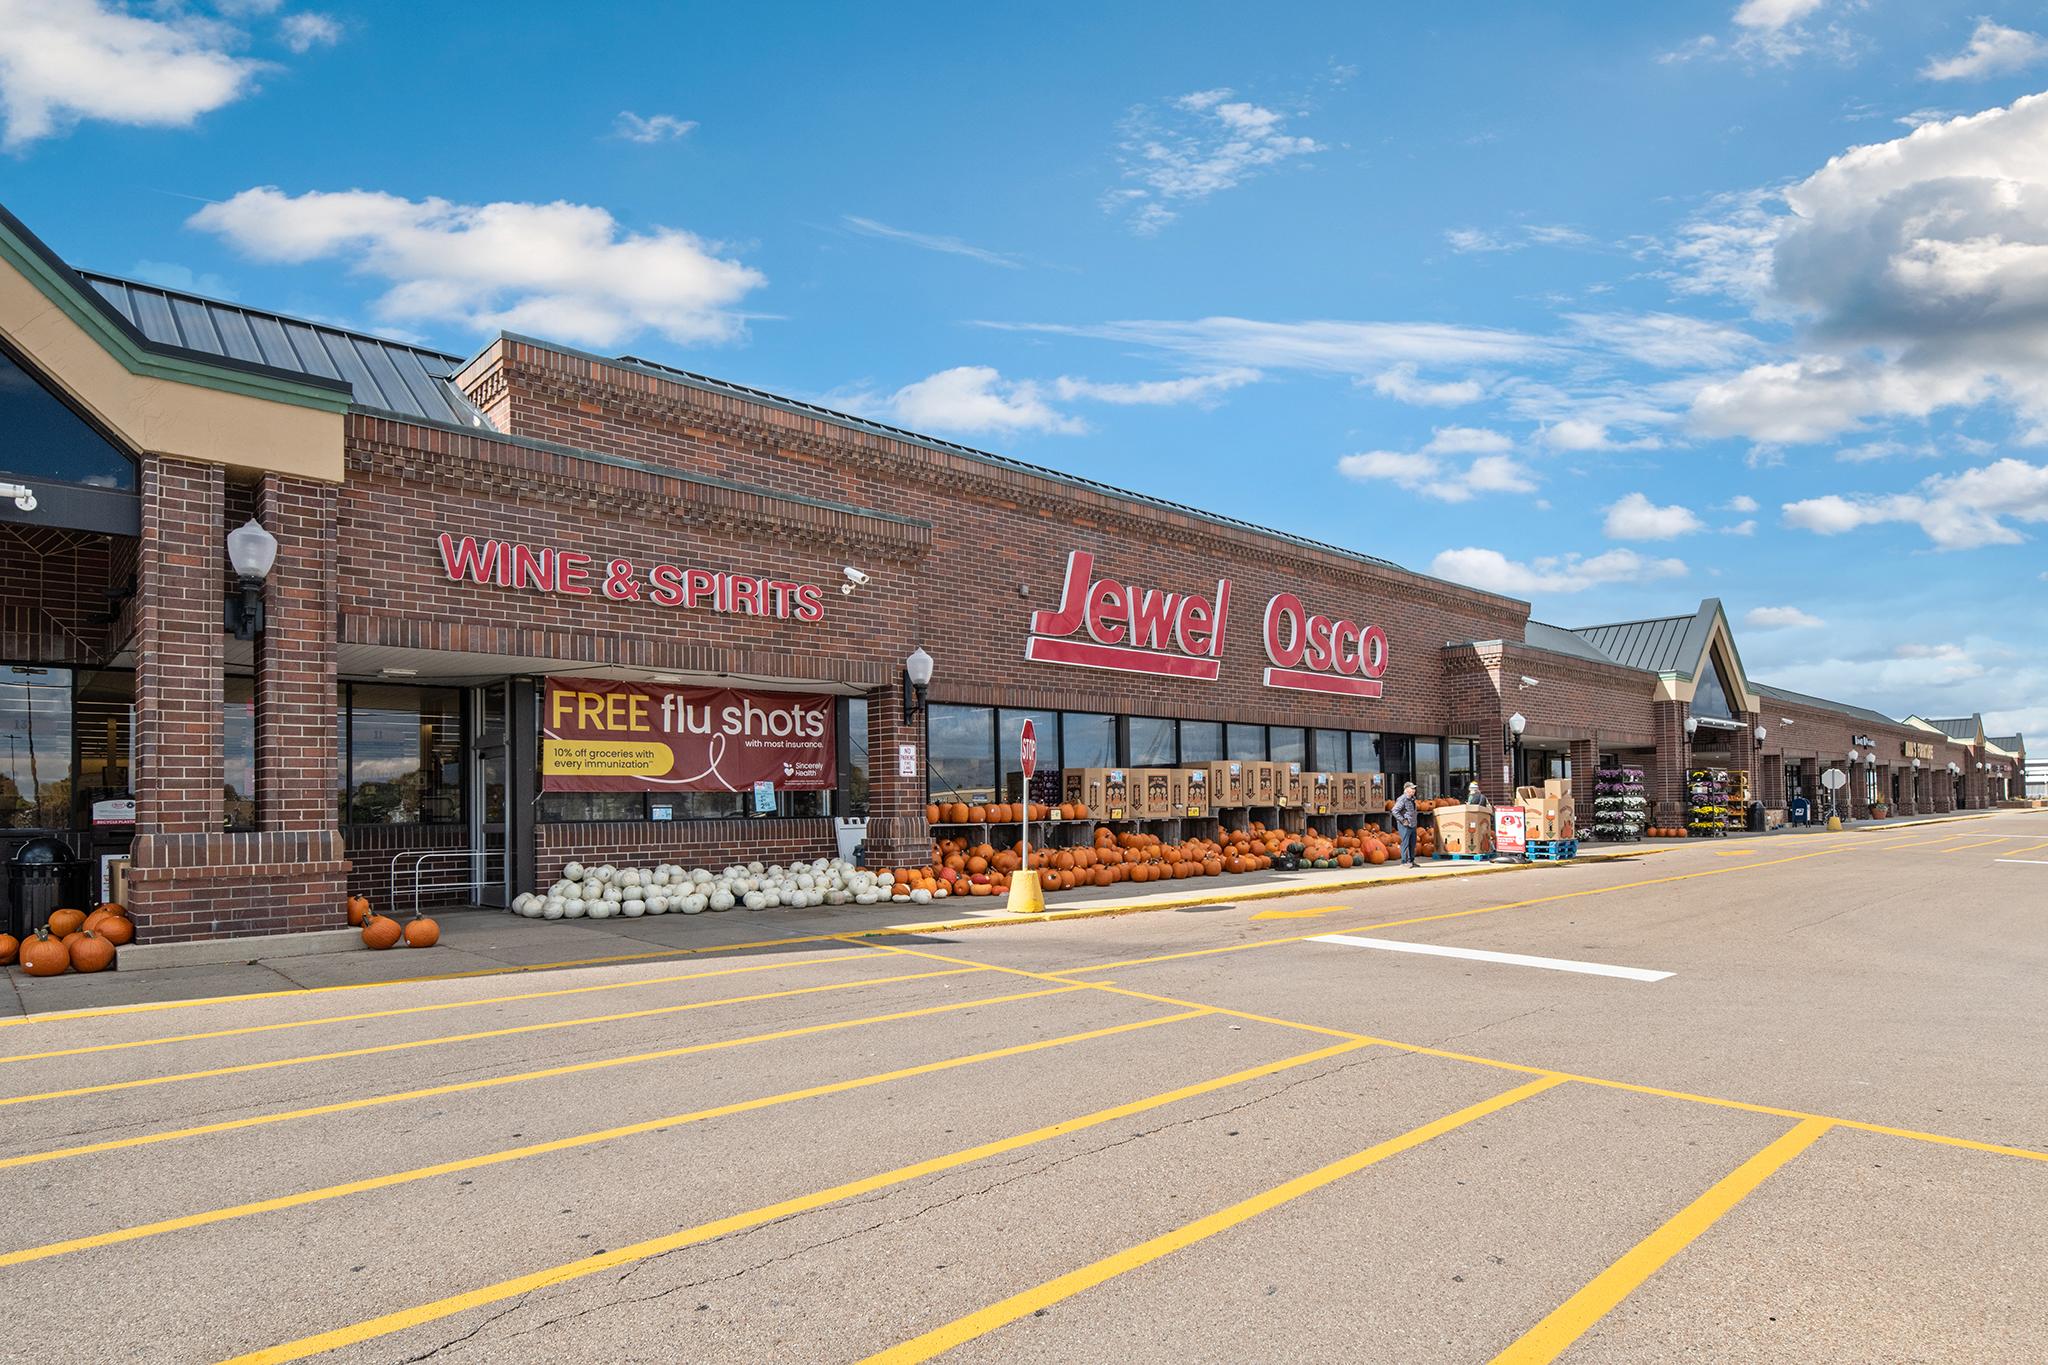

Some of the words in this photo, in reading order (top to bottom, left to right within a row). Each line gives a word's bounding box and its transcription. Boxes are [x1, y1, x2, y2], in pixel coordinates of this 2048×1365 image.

[438, 533, 592, 596] WINE
[602, 559, 641, 601] &
[650, 564, 825, 622] SPIRITS
[1031, 550, 1231, 657] Jewel
[1264, 592, 1389, 679] Osco
[553, 690, 650, 732] FREE
[661, 693, 711, 734] flu
[745, 740, 762, 748] with
[1022, 737, 1036, 761] STOP
[554, 748, 573, 757] 10%
[575, 748, 587, 757] off
[589, 749, 634, 760] groceries
[635, 750, 655, 759] with
[554, 761, 582, 770] every
[795, 762, 824, 771] Sincerely
